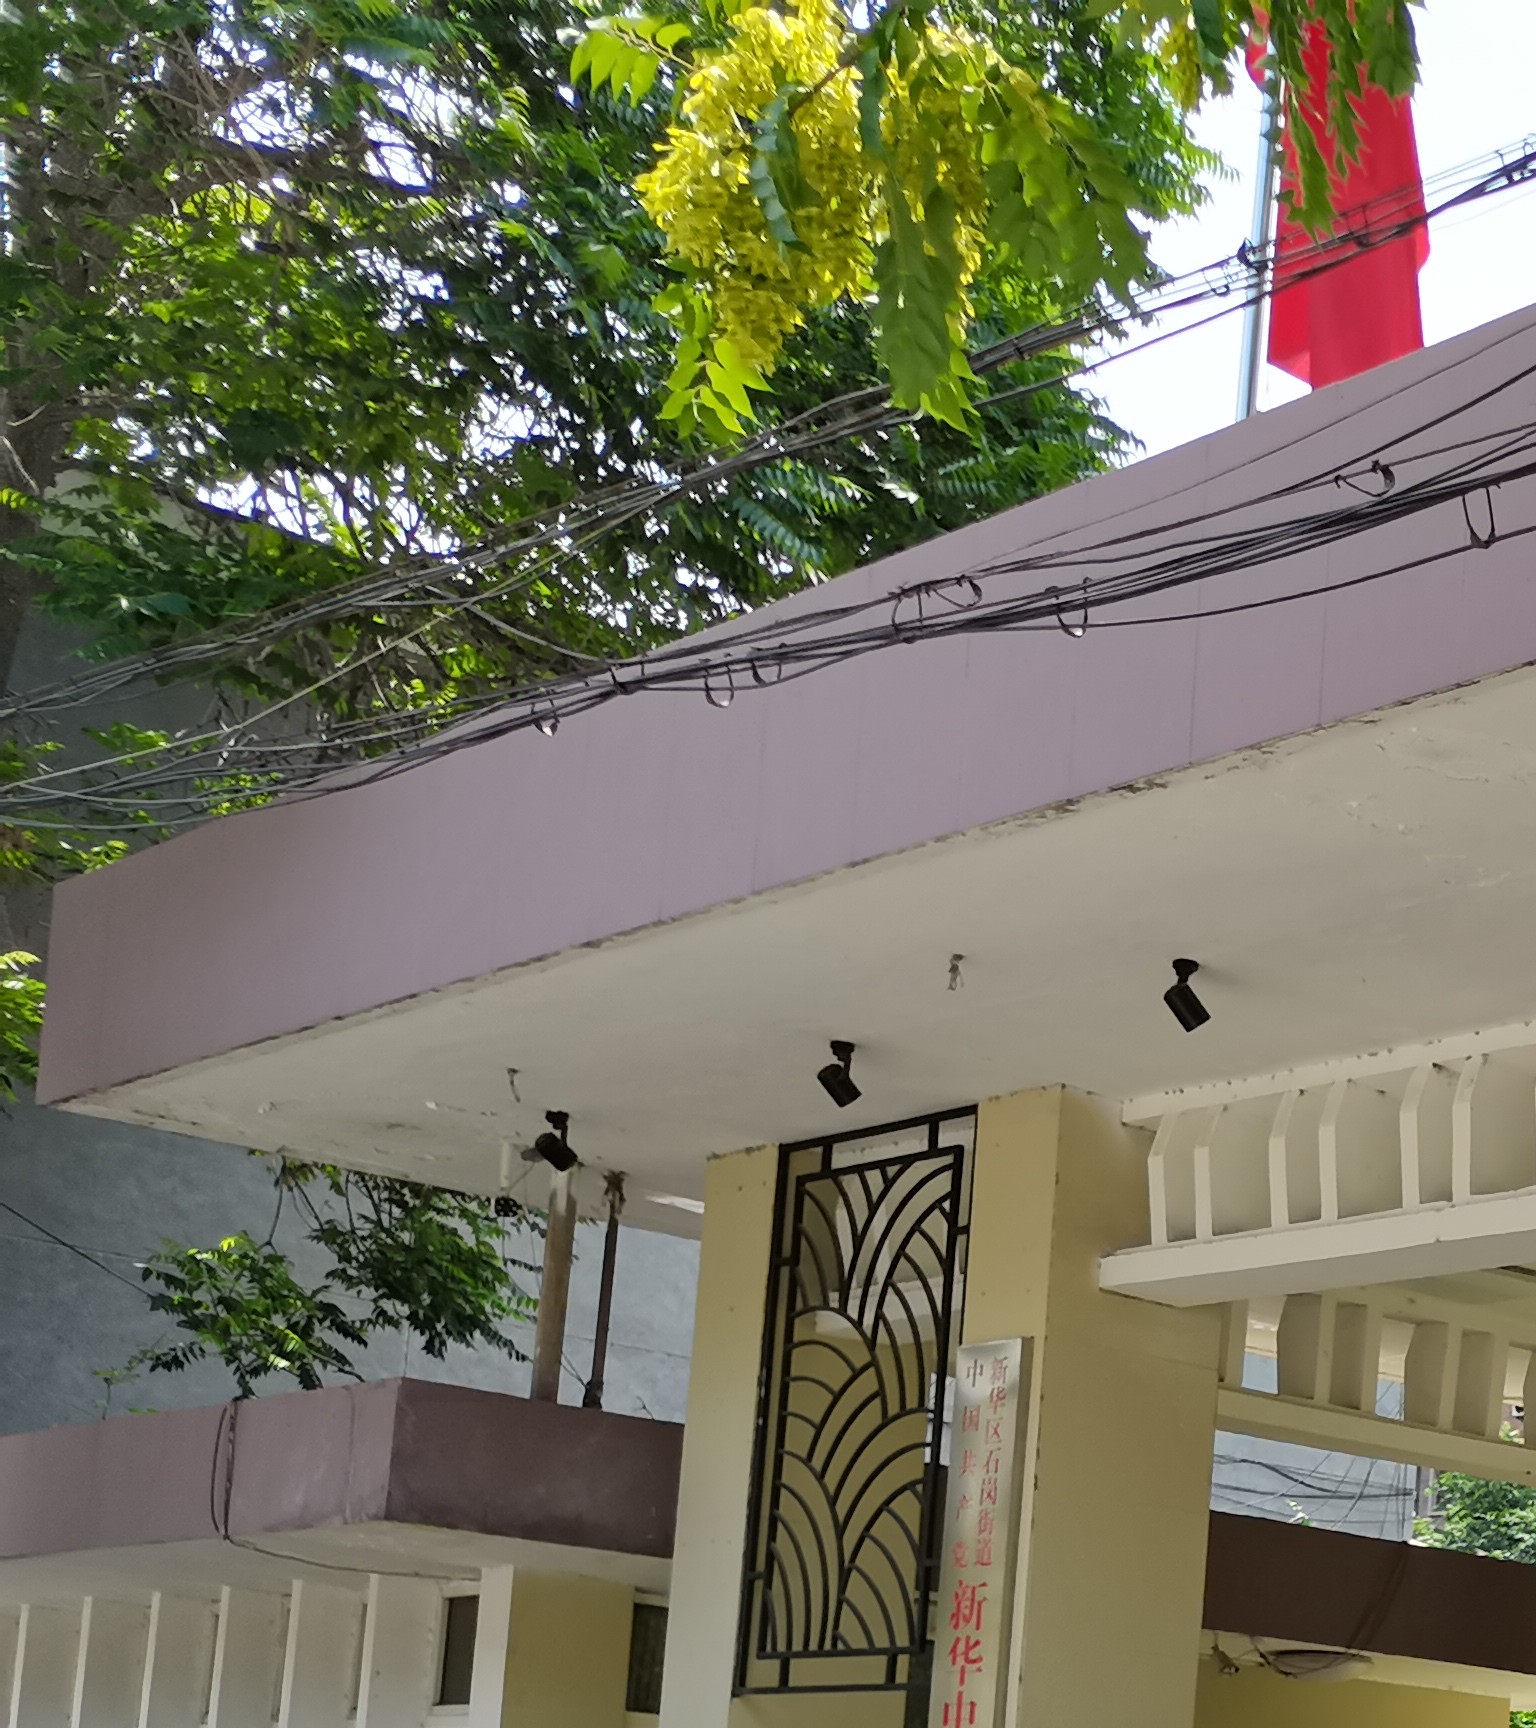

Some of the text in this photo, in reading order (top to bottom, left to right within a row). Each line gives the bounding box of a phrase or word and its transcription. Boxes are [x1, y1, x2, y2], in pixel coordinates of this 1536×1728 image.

[952, 1358, 984, 1568] 中国共产党
[974, 1355, 1009, 1567] 新华区石岗街道
